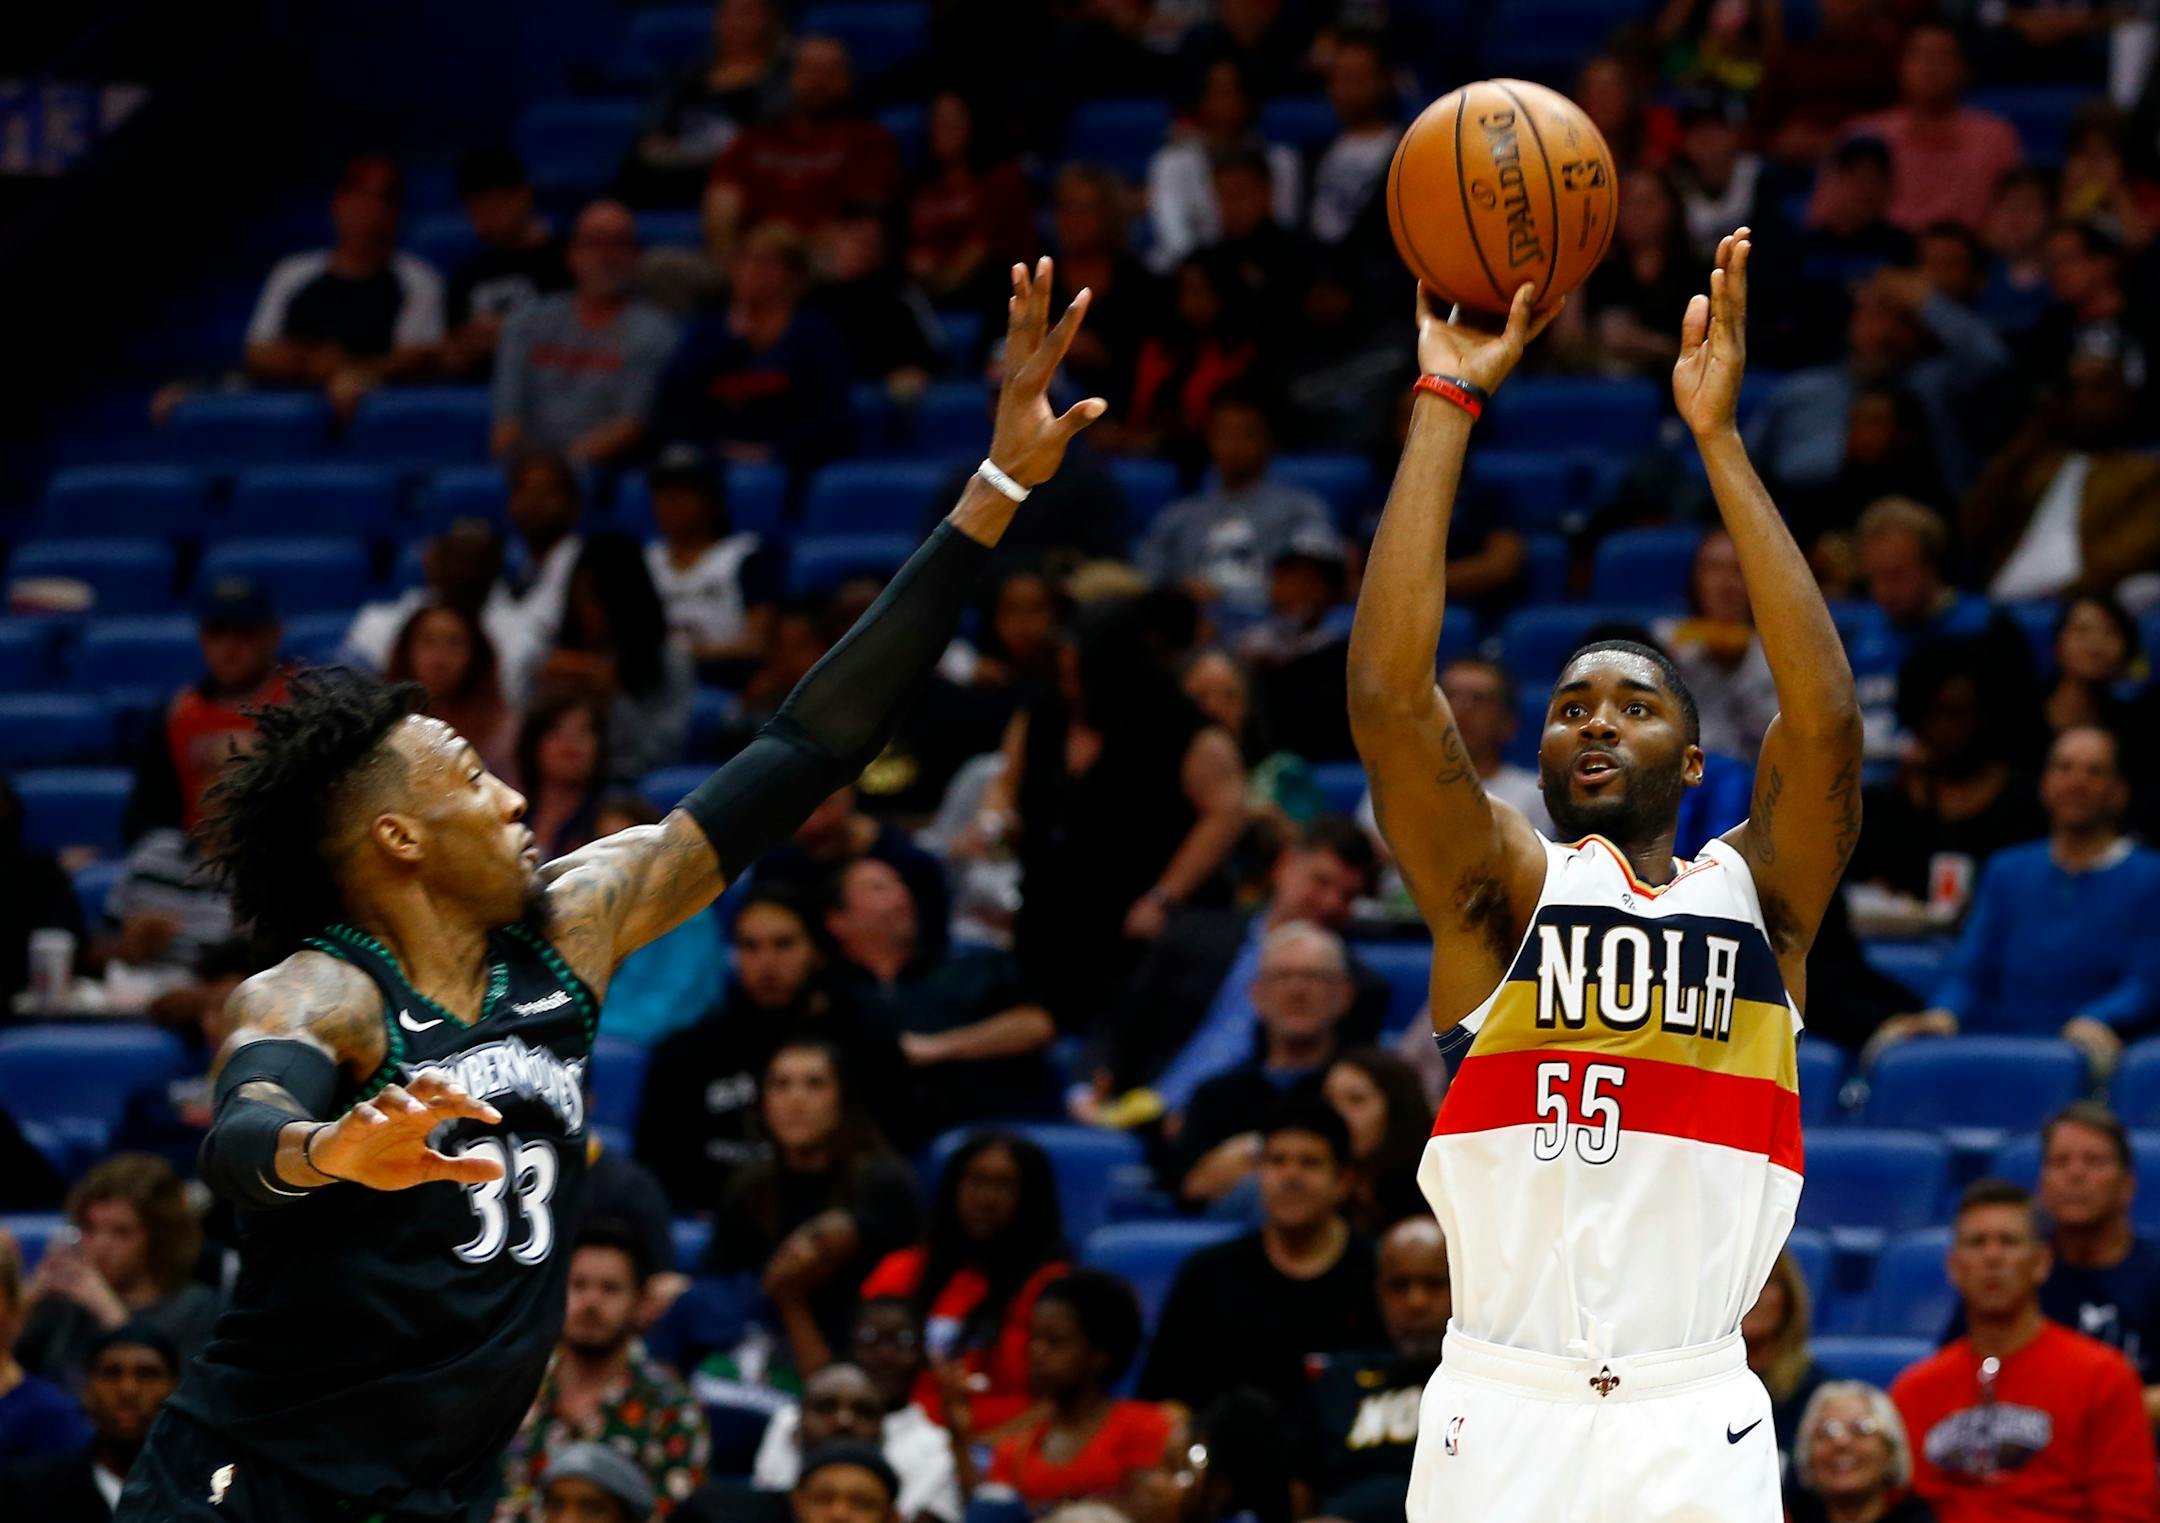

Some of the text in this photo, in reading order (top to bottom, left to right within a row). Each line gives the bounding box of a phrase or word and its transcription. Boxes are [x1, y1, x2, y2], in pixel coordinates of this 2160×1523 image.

[1478, 110, 1546, 270] SPALDING
[1535, 924, 1741, 1043] NOLA
[1533, 1061, 1627, 1165] 55
[451, 1135, 560, 1266] 33
